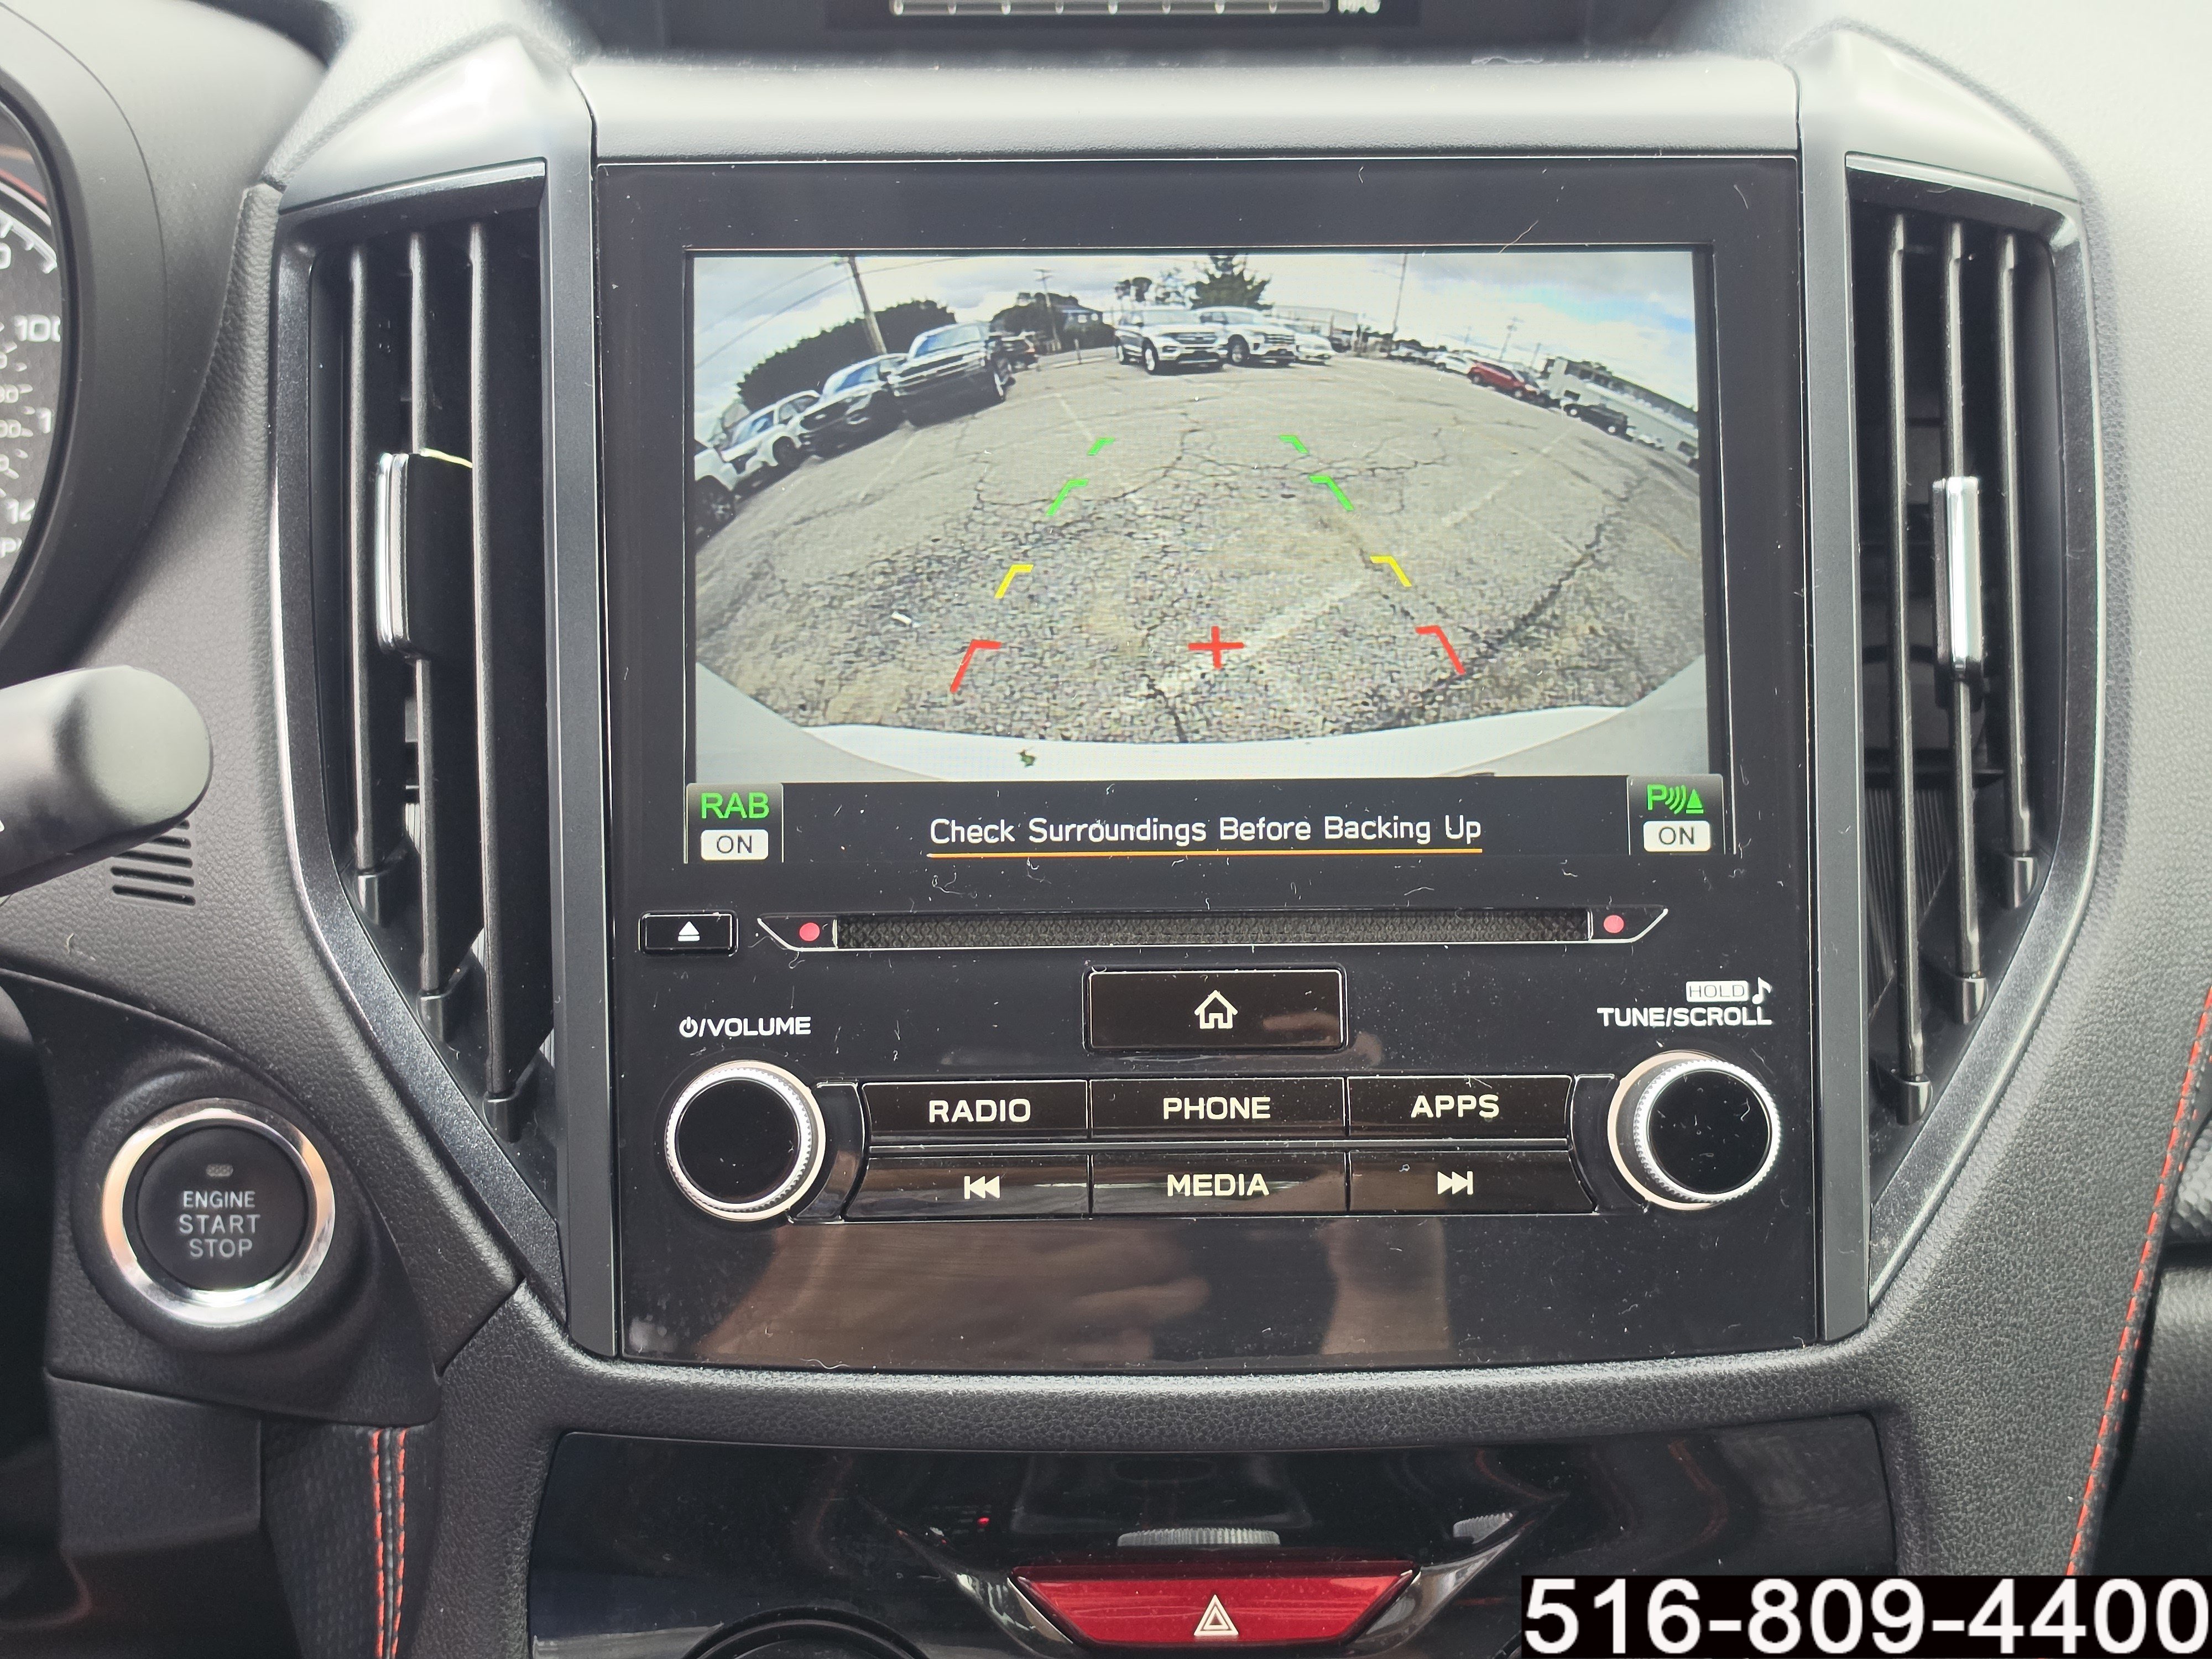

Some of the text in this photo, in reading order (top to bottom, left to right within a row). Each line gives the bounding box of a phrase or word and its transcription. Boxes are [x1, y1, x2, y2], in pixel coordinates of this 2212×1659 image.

[701, 792, 769, 818] RAB
[930, 815, 1481, 847] Check Surroundings Before Backing Up
[1658, 826, 1694, 845] ON
[717, 835, 752, 854] ON
[1689, 984, 1745, 998] HOLD
[1597, 1006, 1773, 1028] TUNE/SCROLL
[929, 1098, 1031, 1123] RADIO
[1163, 1096, 1271, 1120] PHONE
[1411, 1094, 1499, 1119] APPS
[1167, 1173, 1270, 1197] MEDIA
[182, 1190, 255, 1209] ENGINE
[178, 1214, 261, 1235] START
[189, 1238, 253, 1259] STOP
